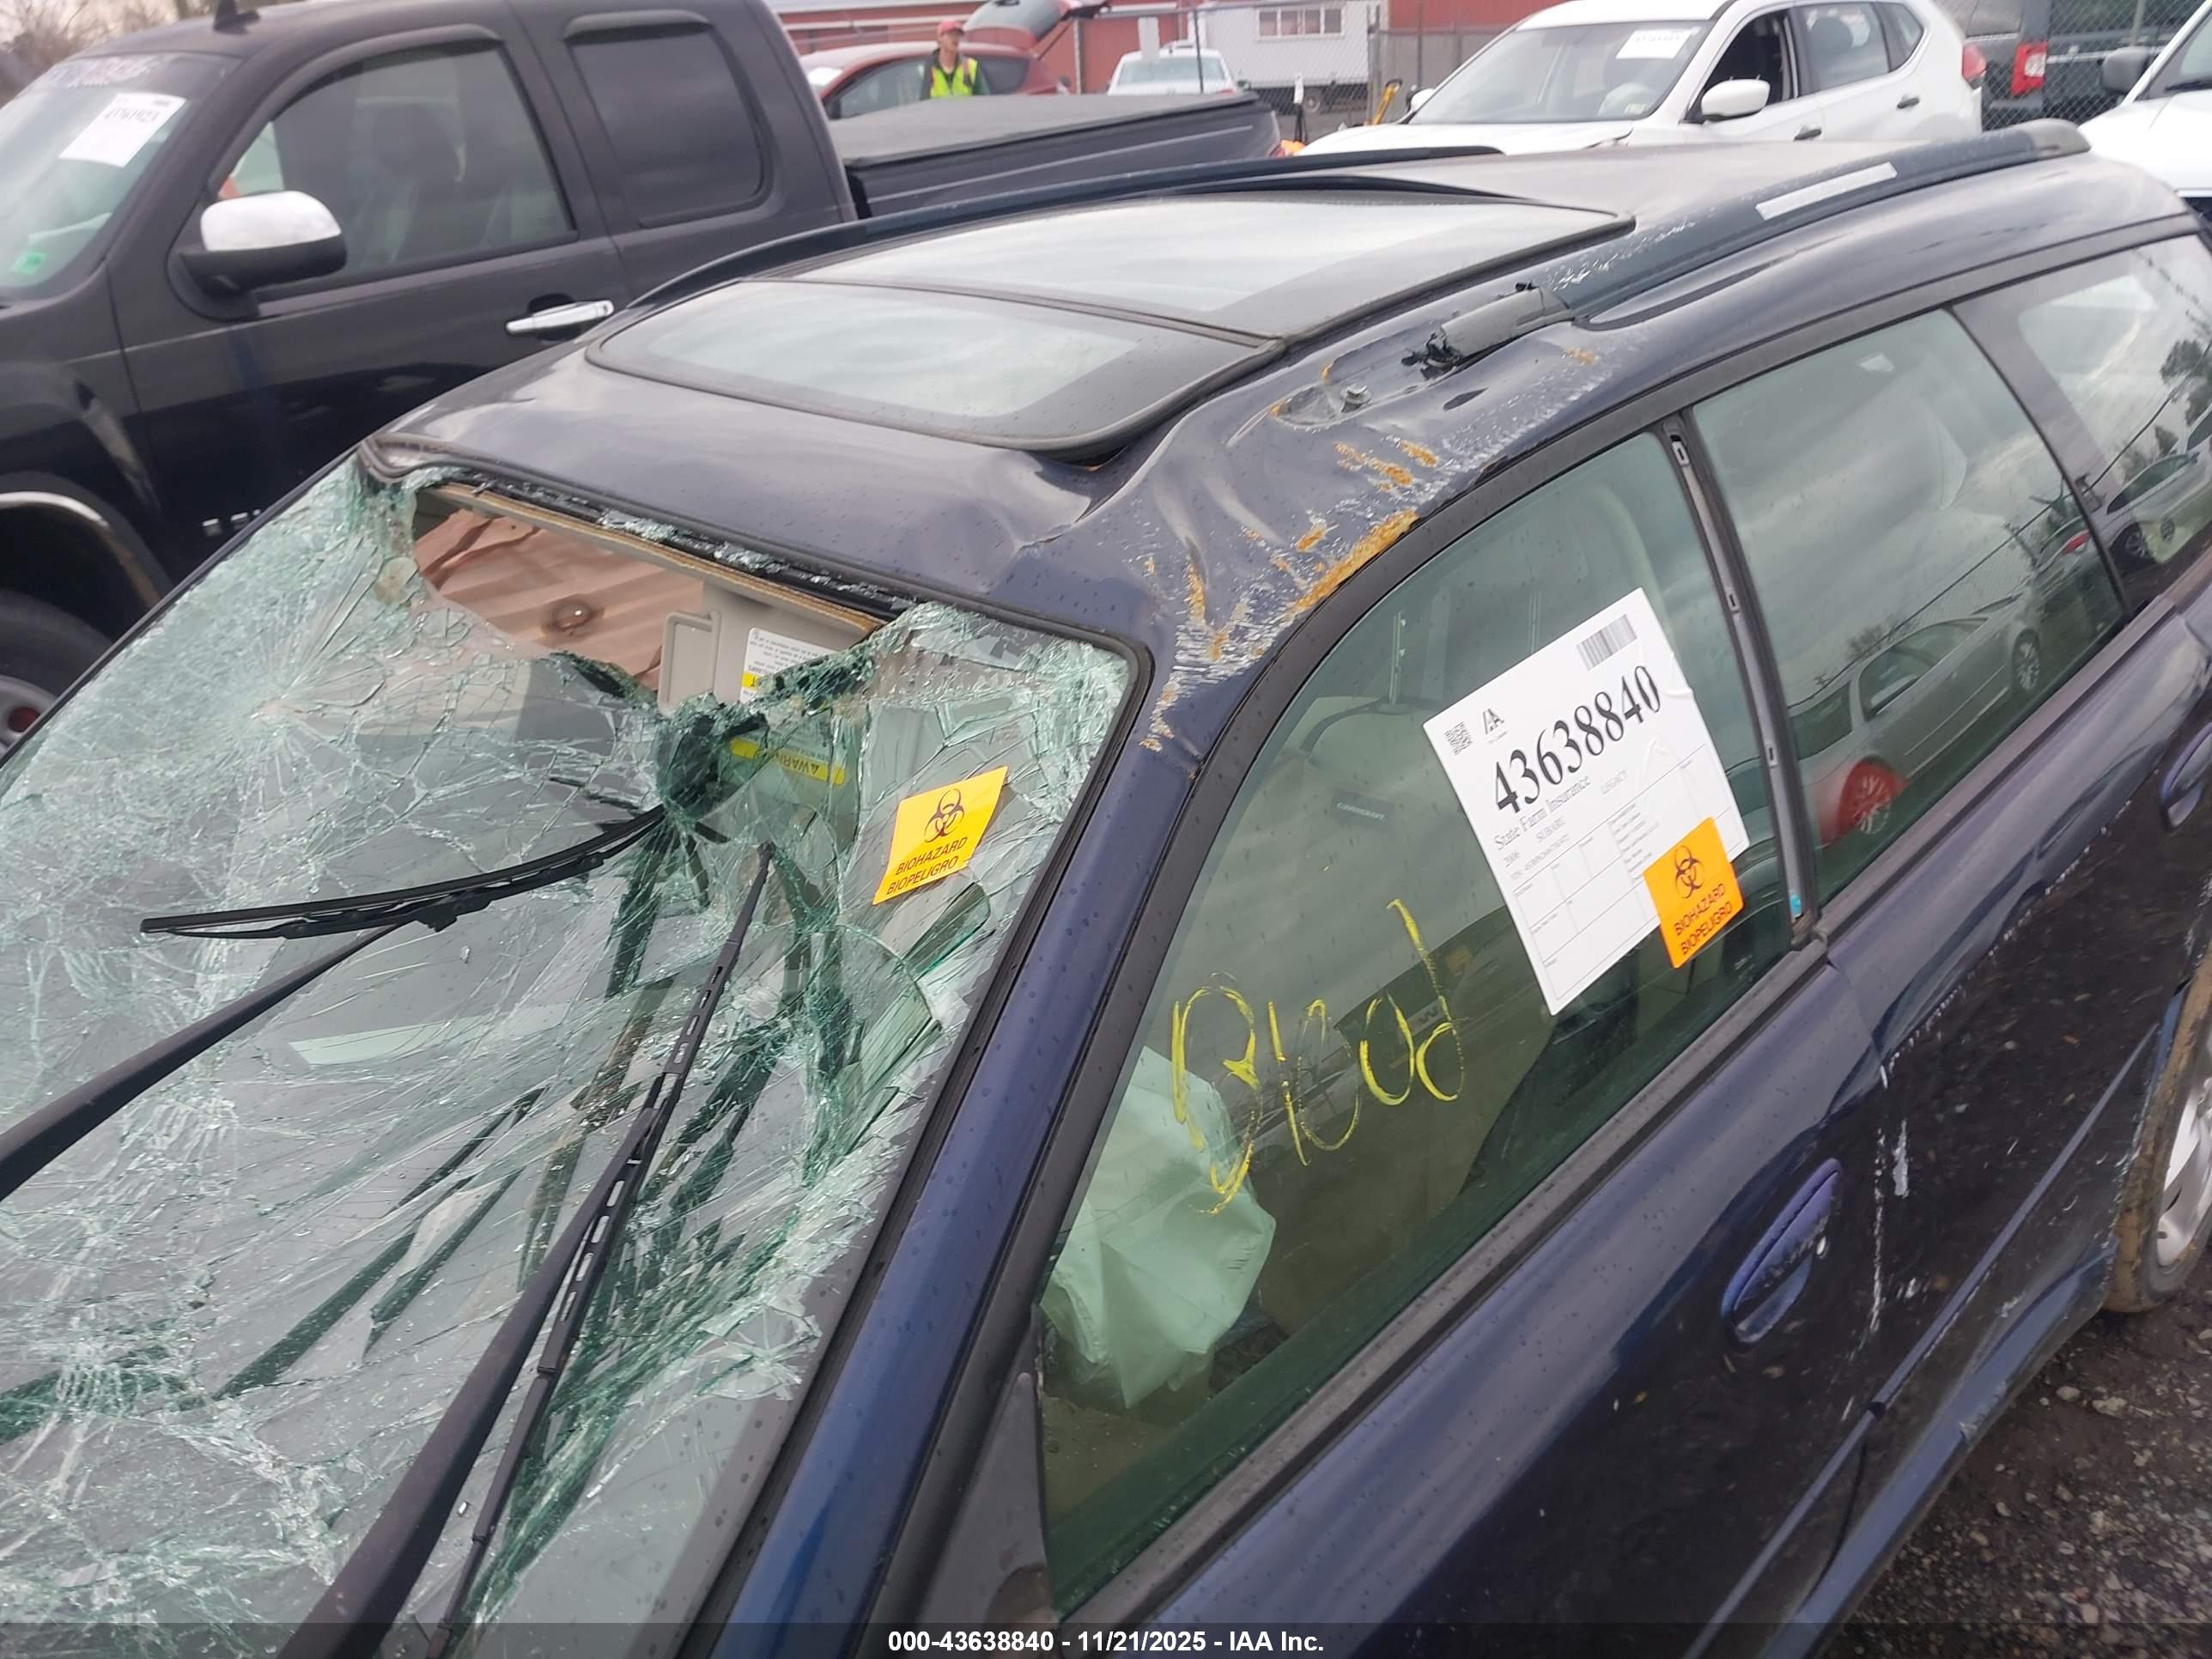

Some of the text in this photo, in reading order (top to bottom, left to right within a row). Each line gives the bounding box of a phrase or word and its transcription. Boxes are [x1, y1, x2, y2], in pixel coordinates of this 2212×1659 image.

[1496, 665, 1661, 813] 43638840
[1494, 776, 1591, 850] State Farm Insurance
[886, 855, 959, 895] BIOPELIGRO
[896, 836, 969, 875] BIOHAZARD
[1674, 883, 1725, 936] BIOHAZARD
[1680, 901, 1732, 955] BIOPELIGRO
